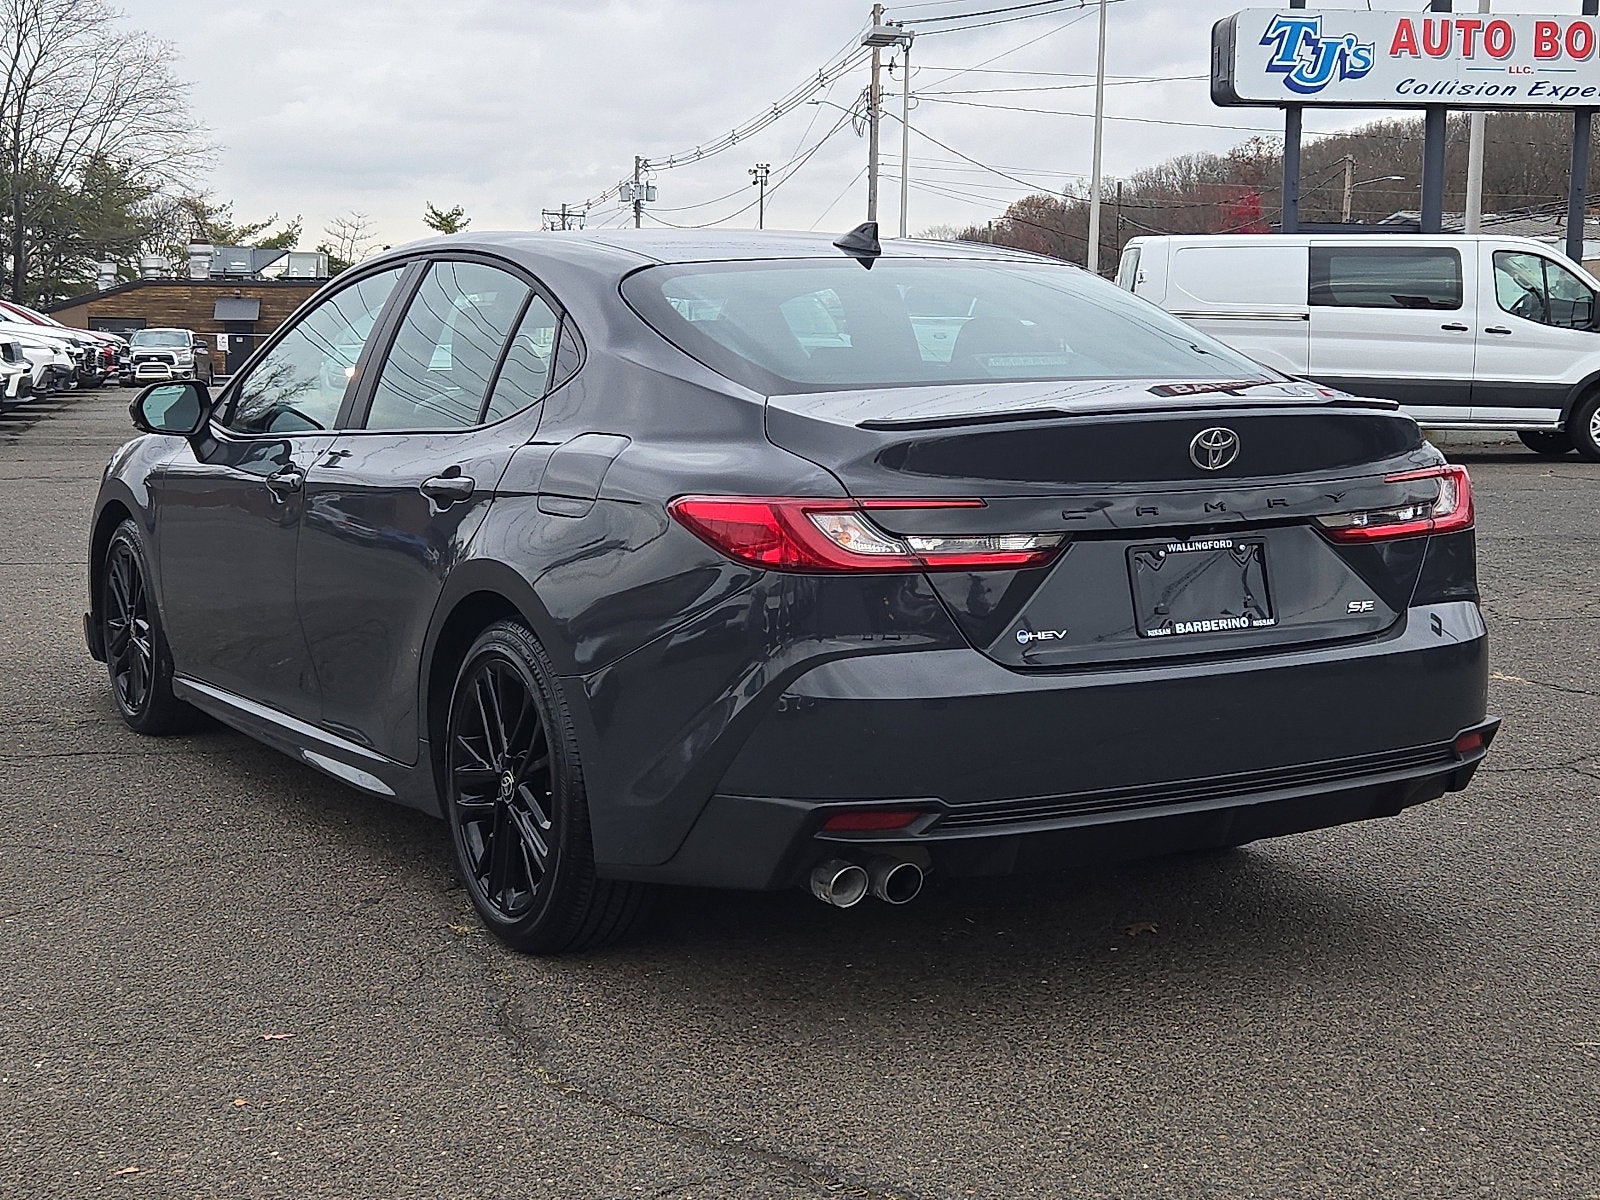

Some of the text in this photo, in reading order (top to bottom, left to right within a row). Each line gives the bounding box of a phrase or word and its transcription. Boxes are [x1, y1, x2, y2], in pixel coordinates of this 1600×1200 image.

[1389, 18, 1514, 59] AUTO
[1534, 21, 1600, 61] BO
[1508, 66, 1535, 75] LLC.
[1395, 79, 1600, 101] Collision Expe
[1061, 491, 1347, 521] CAMRY
[1166, 540, 1233, 553] WALLINGFORD
[1347, 600, 1375, 614] SE
[1147, 616, 1275, 637] NISSAN BARBERINO NISSAN
